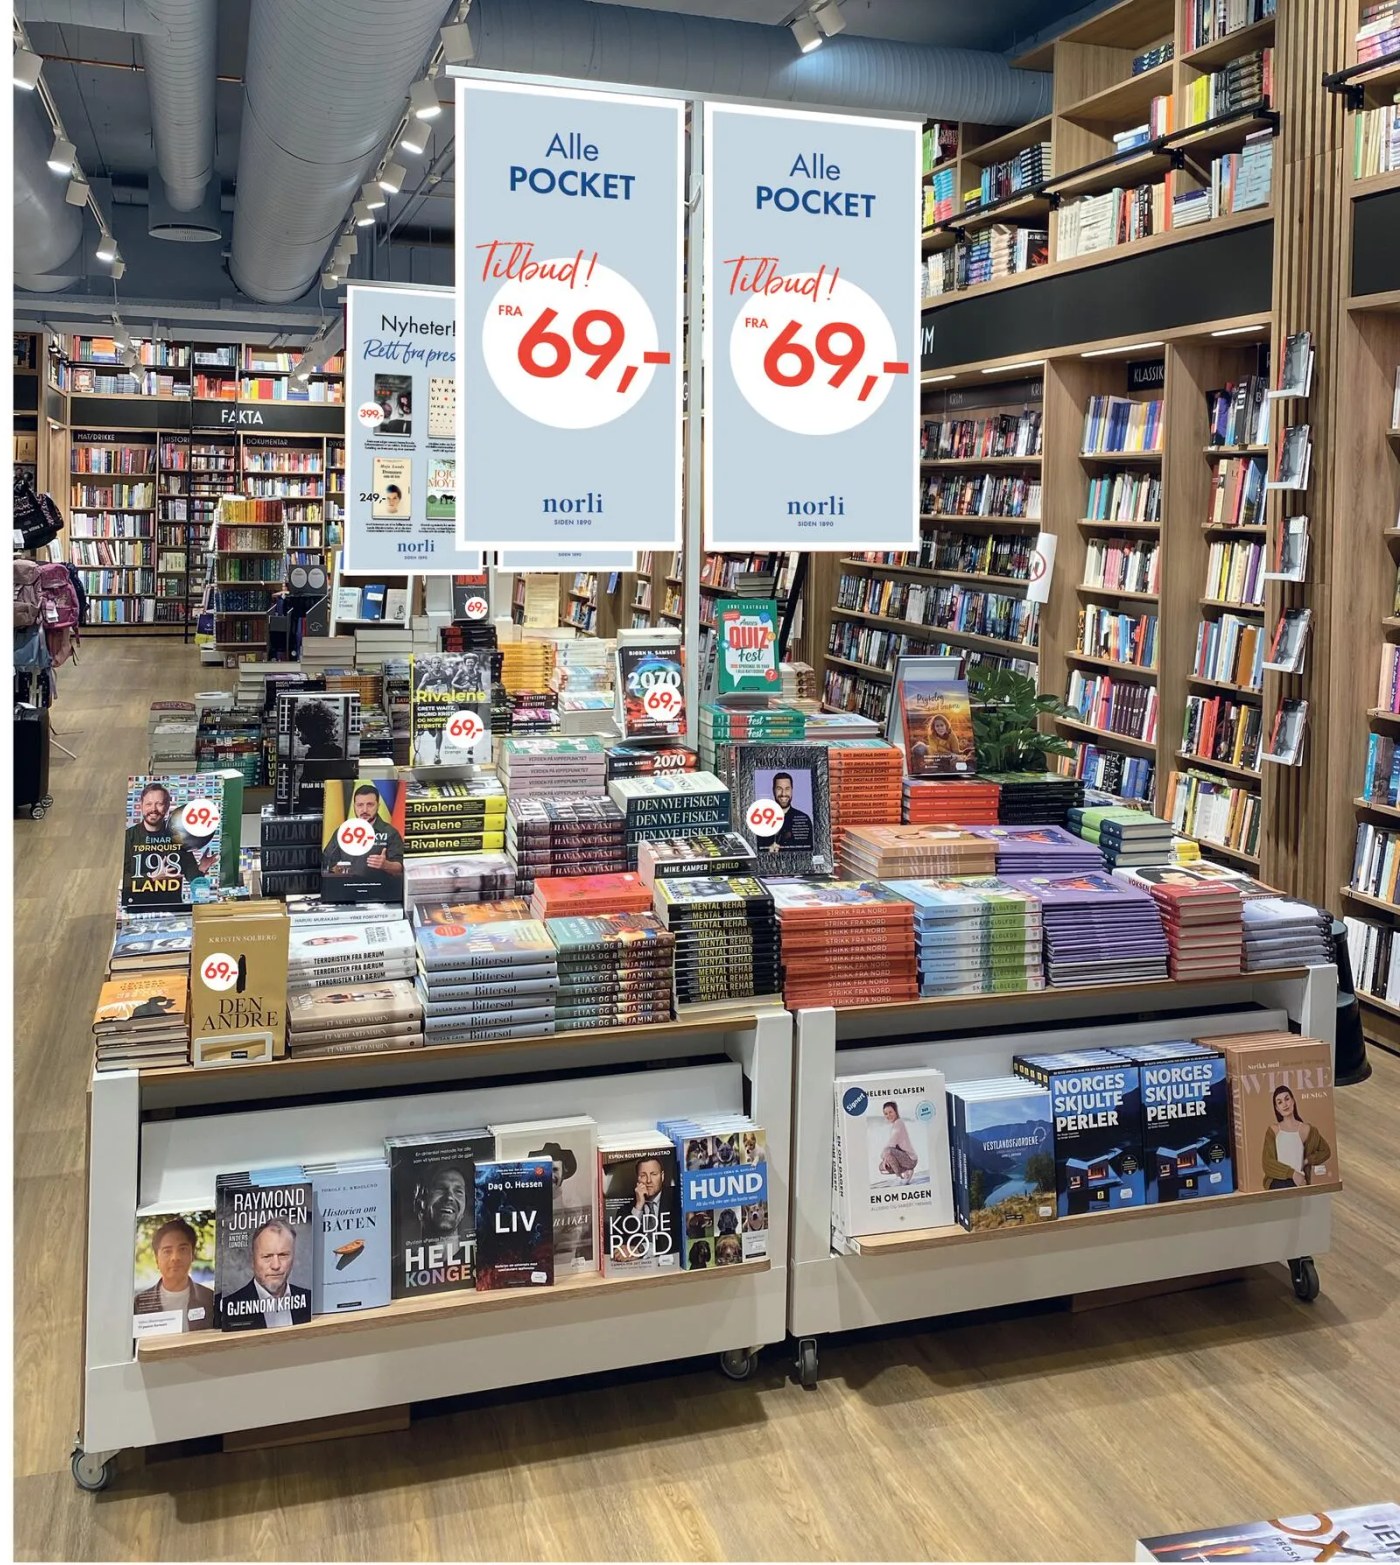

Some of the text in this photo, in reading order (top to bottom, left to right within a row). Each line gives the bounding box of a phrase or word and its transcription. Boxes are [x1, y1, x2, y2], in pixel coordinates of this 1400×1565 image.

[545, 132, 599, 162] Alle
[789, 152, 841, 181] Alle
[510, 165, 636, 200] POCKET
[756, 185, 876, 218] POCKET
[476, 240, 598, 290] Tilbud!
[723, 255, 840, 303] Tilbud!
[498, 305, 523, 317] FRA
[381, 314, 456, 337] Nyheter!
[745, 318, 769, 329] FRA
[363, 339, 456, 368] Rett fra pres
[517, 306, 671, 394] 69,-
[763, 319, 909, 402] 69,-
[222, 409, 264, 425] FAKTA
[360, 409, 384, 420] 399,-
[359, 492, 387, 504] 249,-
[543, 492, 604, 513] norli
[787, 495, 845, 516] norli
[397, 539, 435, 552] norli
[467, 601, 488, 614] 69,-
[647, 691, 681, 713] 69,-
[450, 717, 483, 741] 69,-
[653, 753, 686, 768] 2070
[185, 808, 219, 828] 69,-
[750, 807, 784, 830] 69,-
[341, 827, 375, 848] 69,-
[204, 961, 238, 982] 69,-
[1054, 1073, 1125, 1096] NORGES
[1055, 1090, 1124, 1114] SKJULTE
[1056, 1110, 1119, 1133] PERLER
[690, 1173, 763, 1200] HUND
[234, 1188, 305, 1212] RAYMOND
[495, 1210, 538, 1234] LIV
[609, 1212, 671, 1236] KODE
[609, 1231, 672, 1259] RØD
